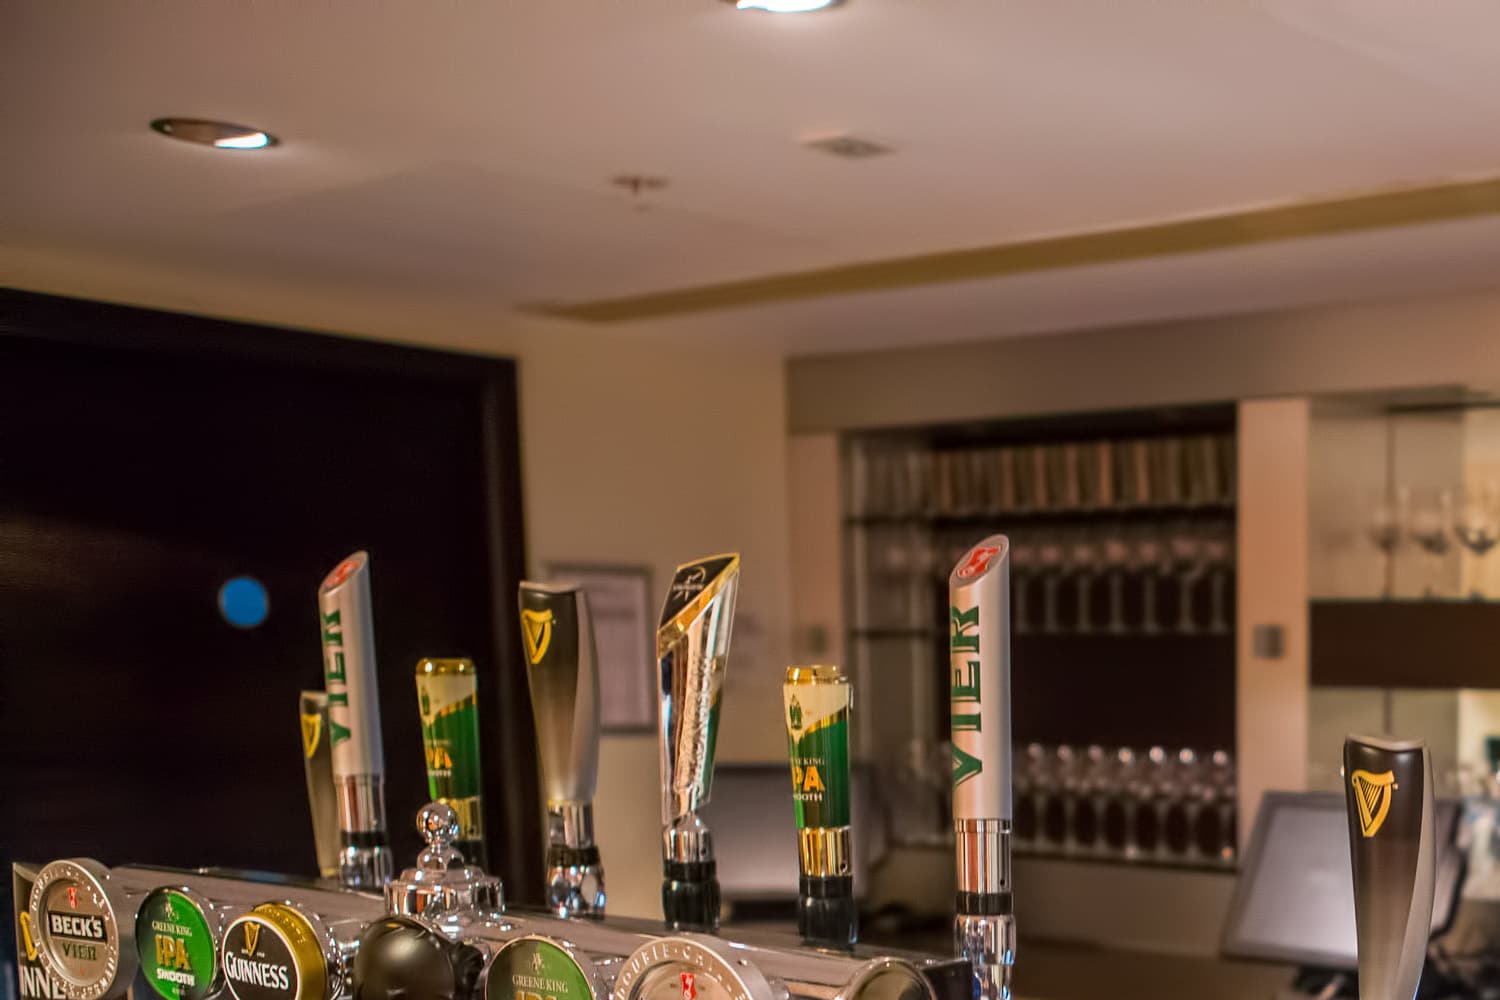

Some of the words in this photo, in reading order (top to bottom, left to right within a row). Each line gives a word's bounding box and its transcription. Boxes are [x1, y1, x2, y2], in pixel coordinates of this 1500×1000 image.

[320, 609, 352, 747] VIER
[950, 605, 983, 790] VIER
[792, 765, 826, 792] PA
[51, 914, 103, 939] BECK'S
[63, 942, 97, 961] VIER
[155, 935, 191, 970] IPA
[156, 968, 196, 987] SMOOTH
[226, 951, 290, 990] GUINNESS
[512, 975, 546, 990] GREENE
[546, 978, 569, 993] KING
